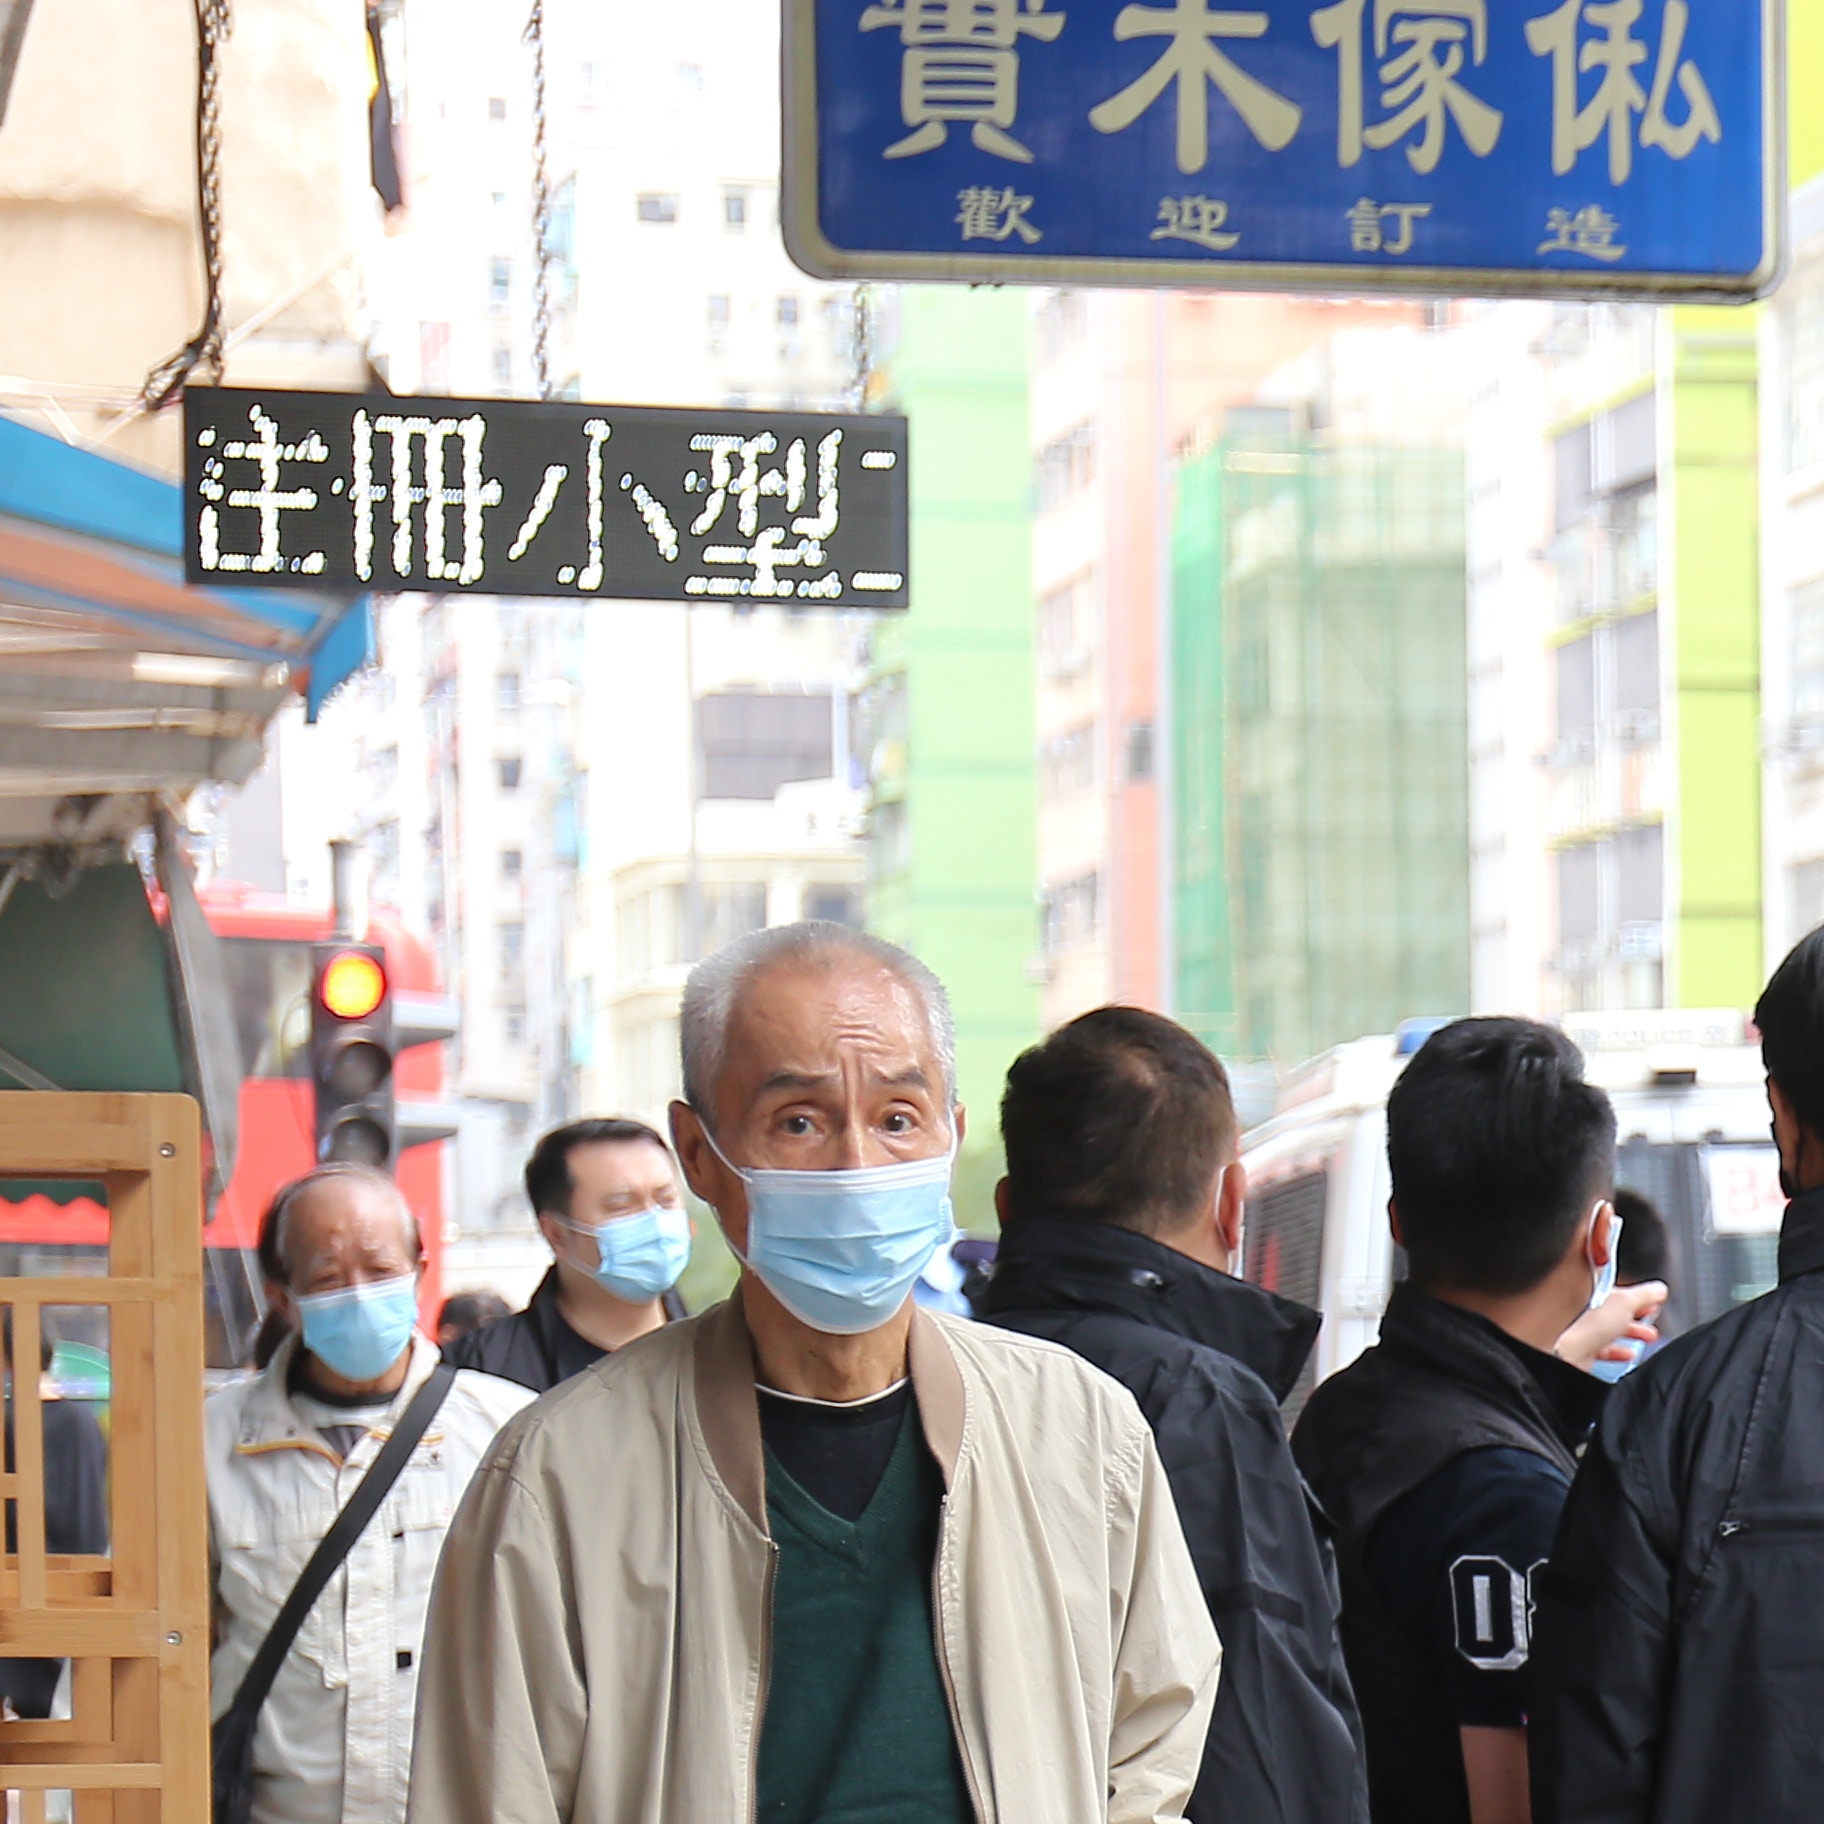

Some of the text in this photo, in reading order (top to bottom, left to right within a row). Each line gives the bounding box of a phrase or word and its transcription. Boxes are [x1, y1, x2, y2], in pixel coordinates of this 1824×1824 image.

[955, 184, 1628, 263] 歡迎訂造
[199, 403, 904, 597] 注冊小型
